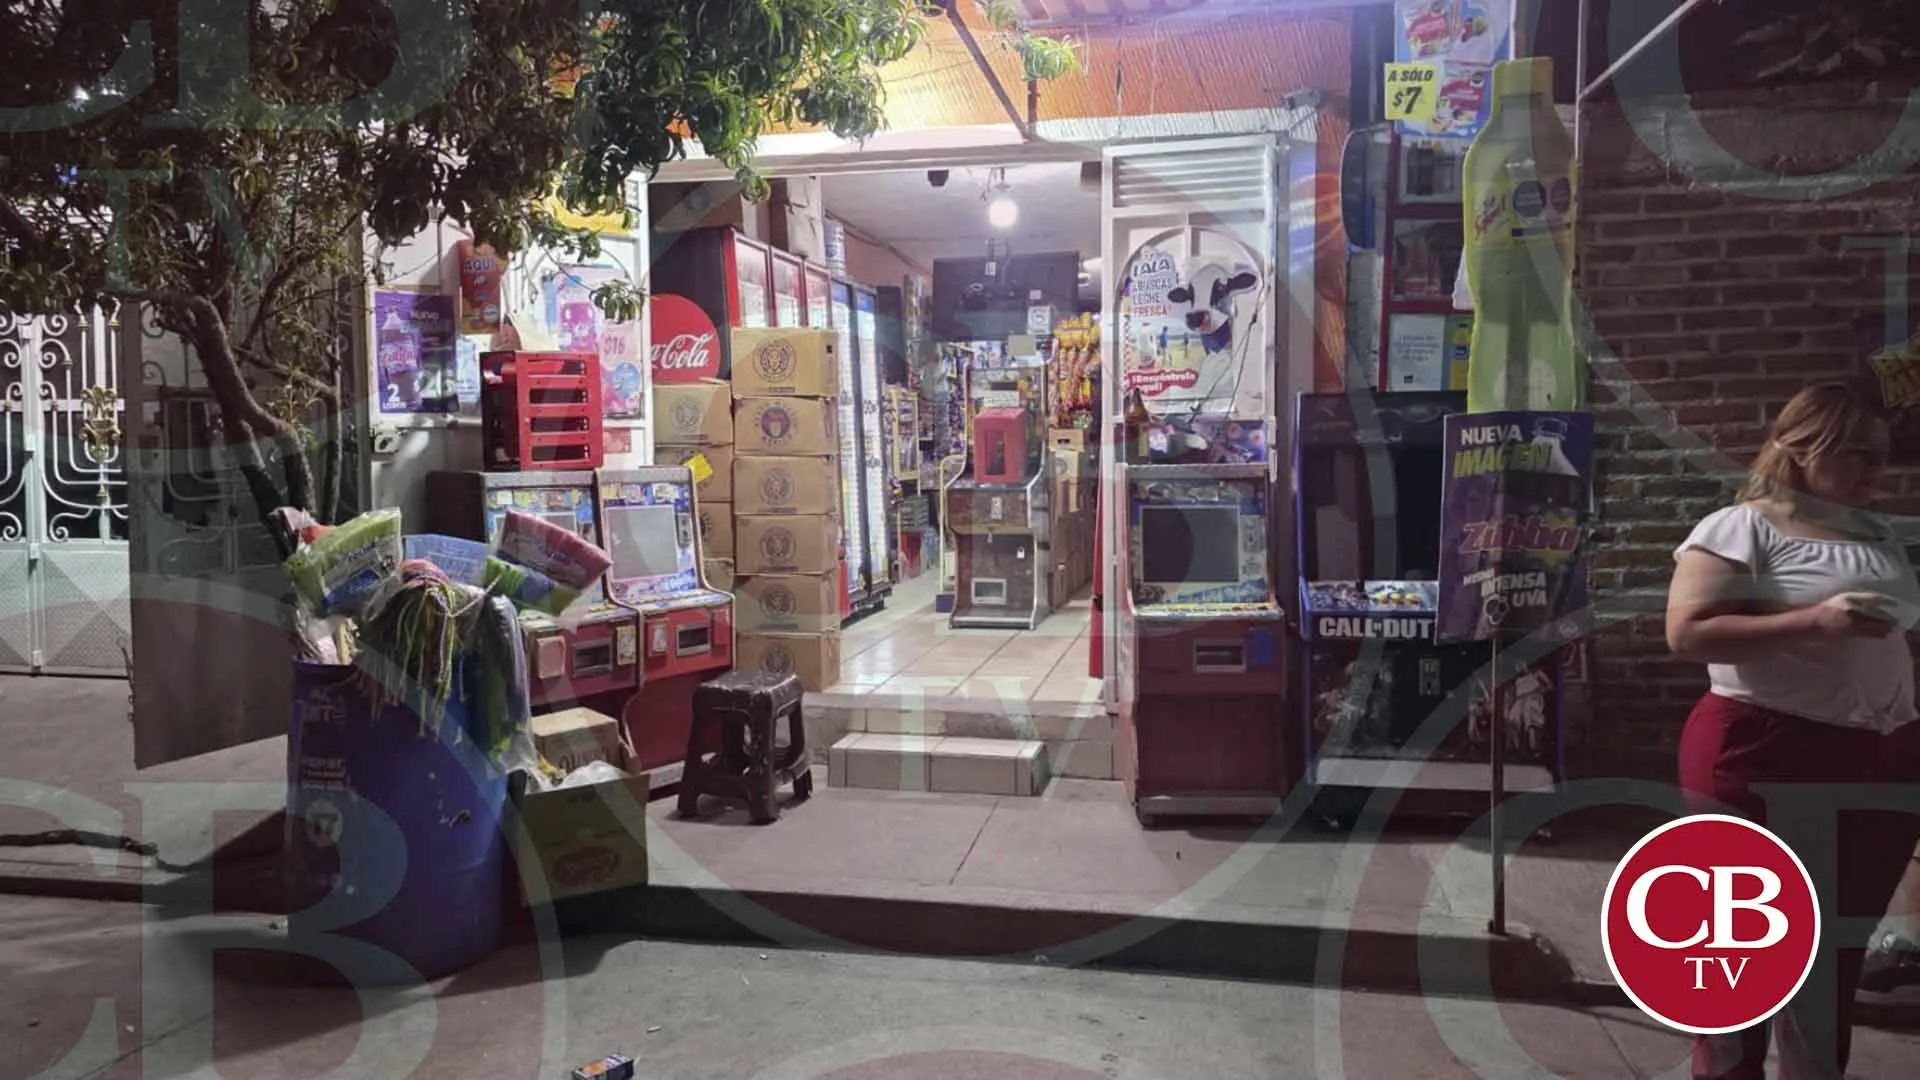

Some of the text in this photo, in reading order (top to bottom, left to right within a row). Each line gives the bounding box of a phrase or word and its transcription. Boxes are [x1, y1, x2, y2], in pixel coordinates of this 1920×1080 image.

[1388, 67, 1434, 82] A SÓLO
[1392, 87, 1422, 115] $7
[1133, 259, 1170, 277] LALA
[651, 334, 713, 369] a-Cola
[387, 384, 400, 402] 2
[1461, 424, 1523, 446] NUEVA
[1453, 442, 1552, 478] IMAGEN
[1480, 571, 1547, 598] INTENSA
[1512, 589, 1548, 607] UVA
[1319, 617, 1375, 638] CALL
[1383, 618, 1435, 639] DUT
